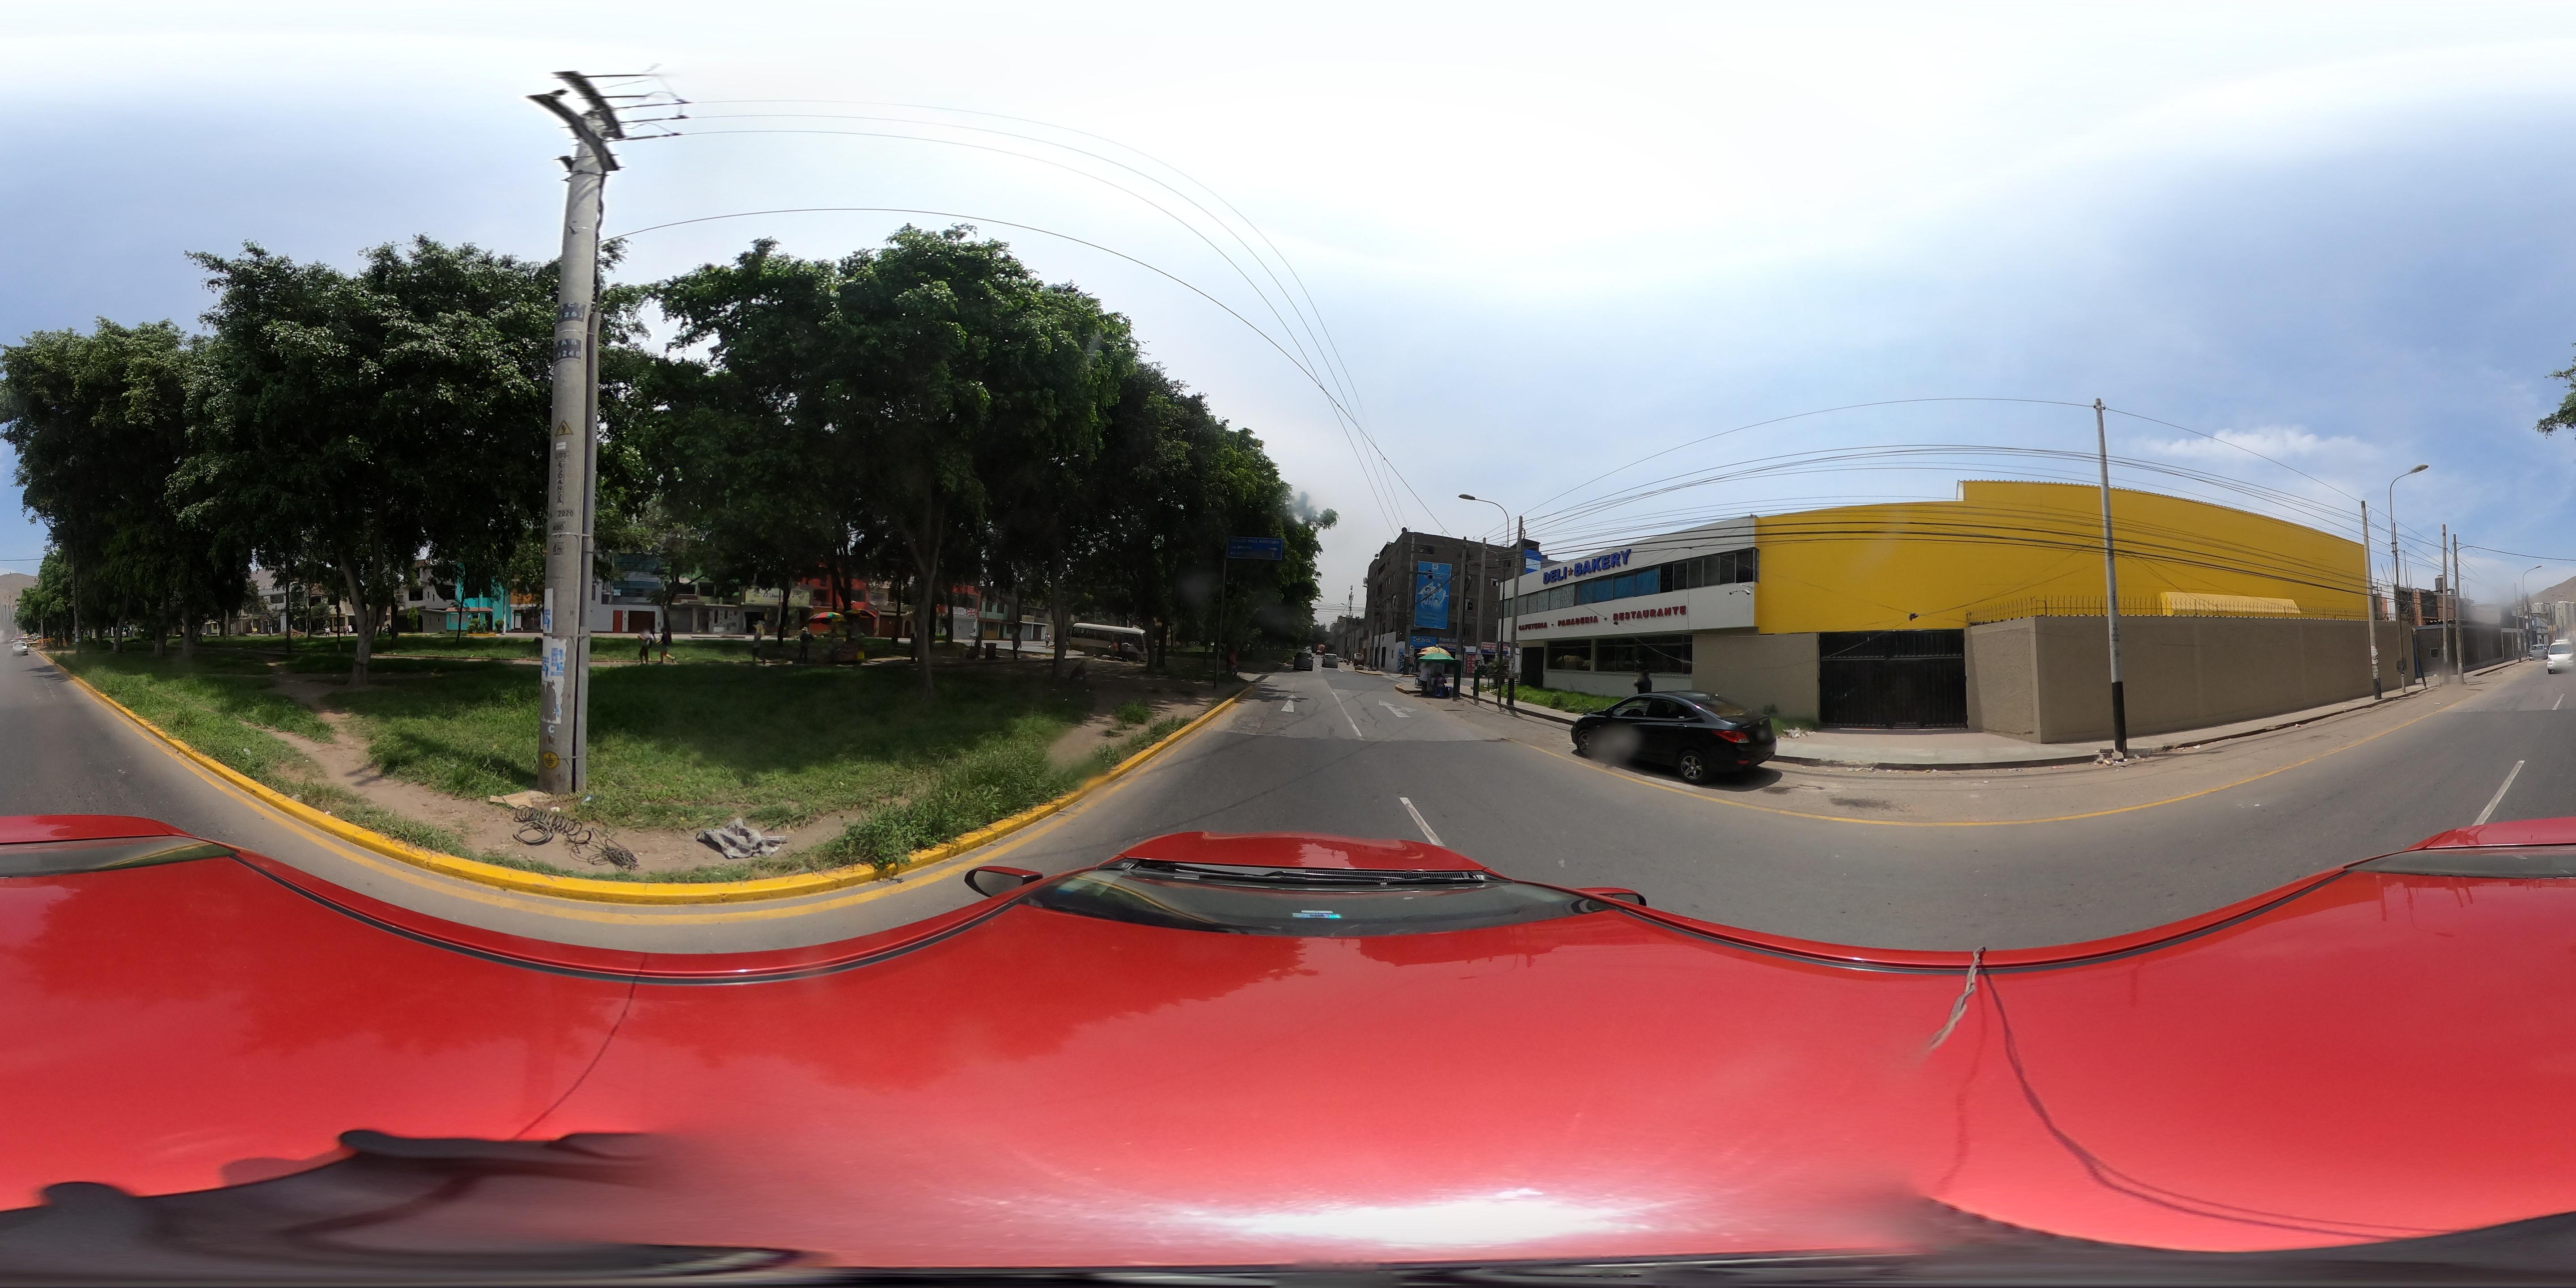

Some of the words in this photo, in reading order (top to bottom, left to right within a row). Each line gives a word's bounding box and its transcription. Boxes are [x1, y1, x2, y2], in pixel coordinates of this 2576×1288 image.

[1543, 566, 1568, 584] DELI
[1574, 548, 1631, 576] BAKERY
[1518, 622, 1547, 631] CAFETERIA
[1558, 616, 1598, 627] PANADERIA
[1613, 606, 1686, 621] RESTAURANTE
